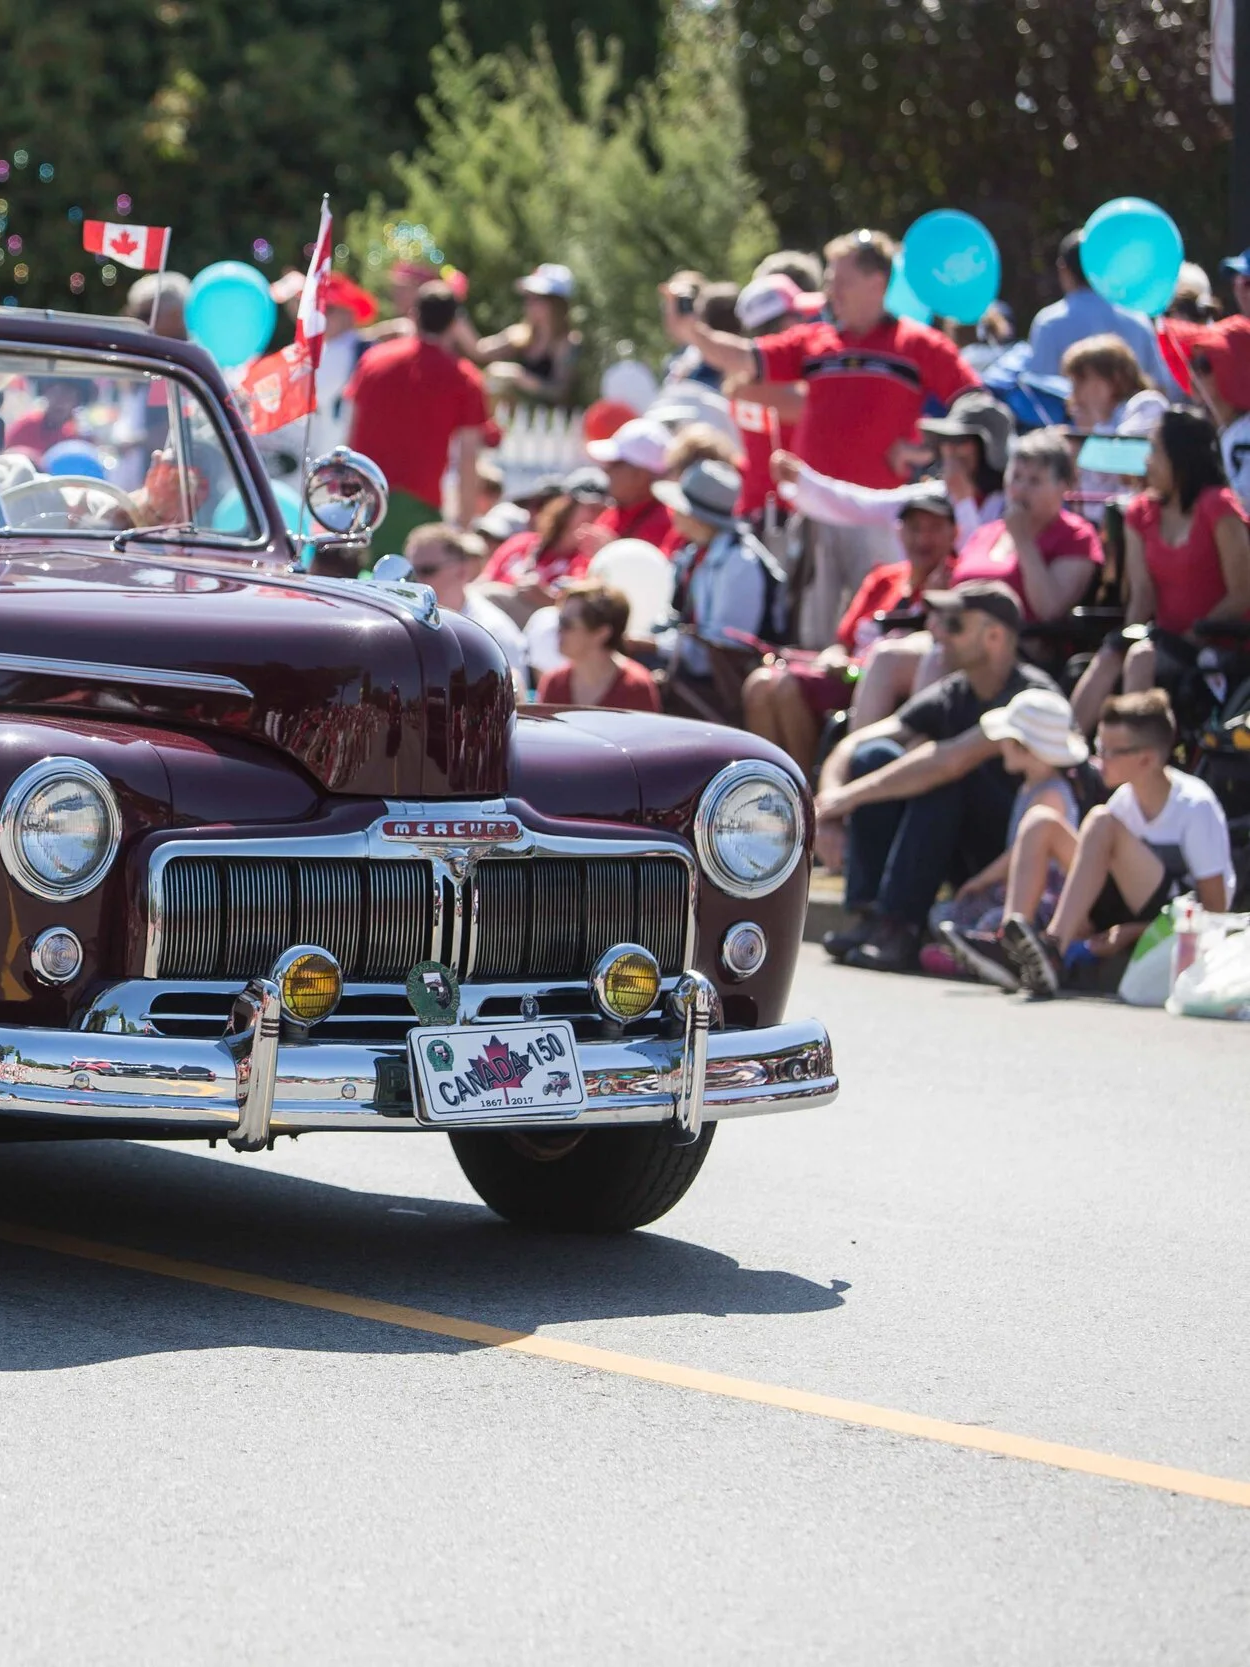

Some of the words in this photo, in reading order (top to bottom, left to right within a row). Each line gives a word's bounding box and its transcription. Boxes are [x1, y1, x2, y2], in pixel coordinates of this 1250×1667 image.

[394, 822, 512, 835] MERCURY
[438, 1050, 533, 1106] CANADA
[527, 1033, 566, 1067] 150
[480, 1098, 503, 1107] 1867
[511, 1097, 534, 1105] 2017
